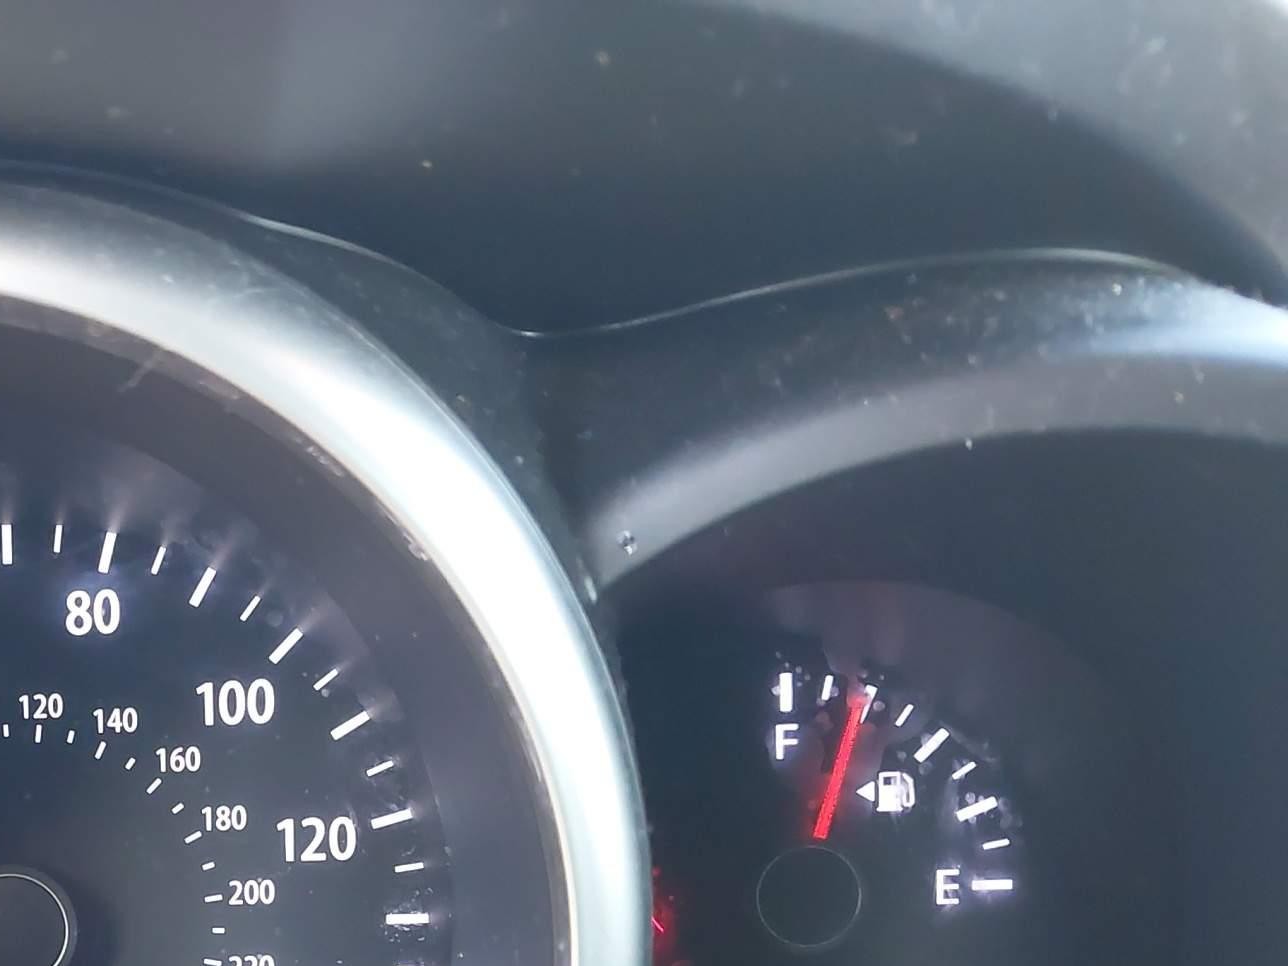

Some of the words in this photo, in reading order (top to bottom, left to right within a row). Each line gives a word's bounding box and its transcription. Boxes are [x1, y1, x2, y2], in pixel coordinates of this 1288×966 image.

[65, 588, 121, 636] 80
[18, 693, 63, 720] 120
[195, 678, 275, 726] 100
[93, 707, 138, 734] 140
[775, 723, 799, 760] F
[155, 746, 201, 773] 160
[201, 804, 247, 832] 180
[276, 816, 357, 862] 120
[228, 879, 276, 906] 200
[935, 867, 960, 907] E
